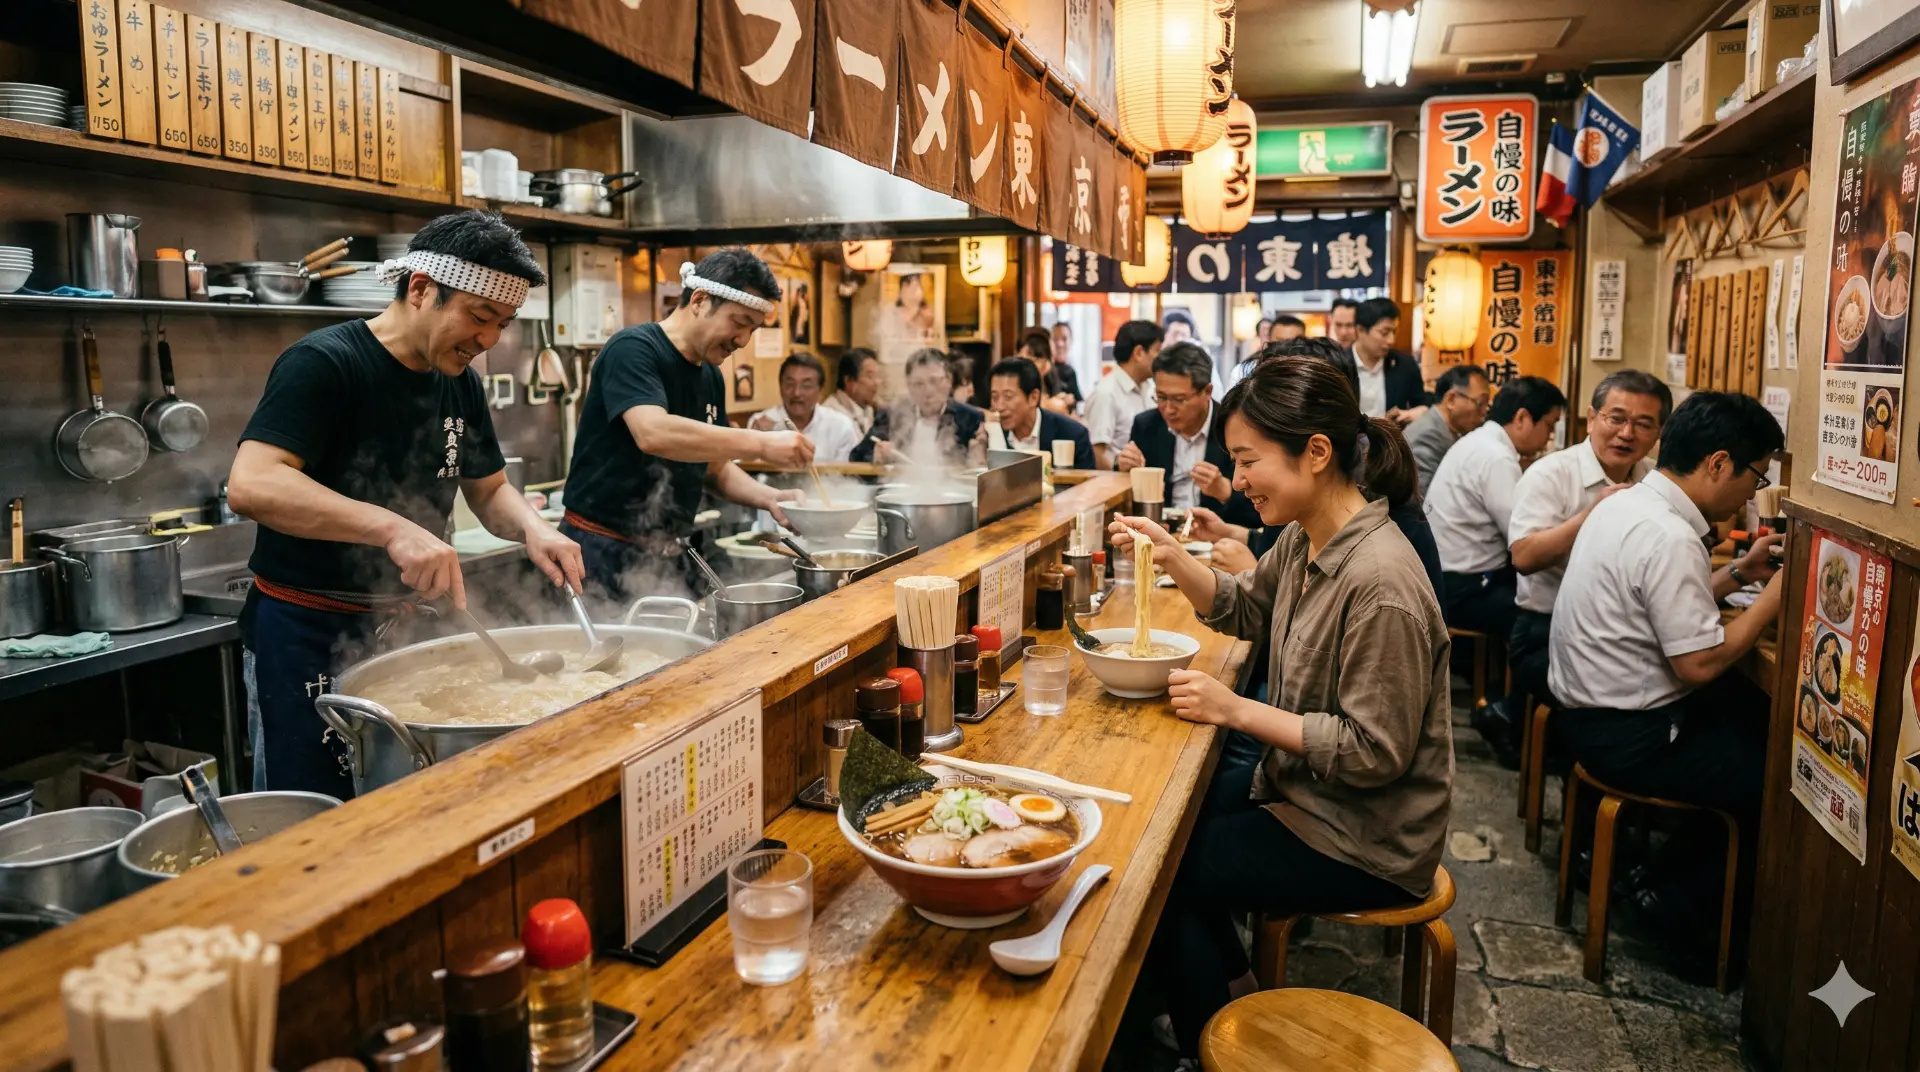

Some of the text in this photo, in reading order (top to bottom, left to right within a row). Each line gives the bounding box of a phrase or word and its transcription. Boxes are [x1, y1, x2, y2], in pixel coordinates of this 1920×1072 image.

[165, 128, 187, 144] 650
[197, 134, 219, 150] 650
[228, 139, 249, 155] 350
[257, 144, 278, 160] 350
[1225, 123, 1252, 210] ラーメン
[1440, 110, 1485, 225] ラーメン
[1491, 111, 1524, 224] 自慢の味
[1486, 262, 1524, 387] 自慢の味
